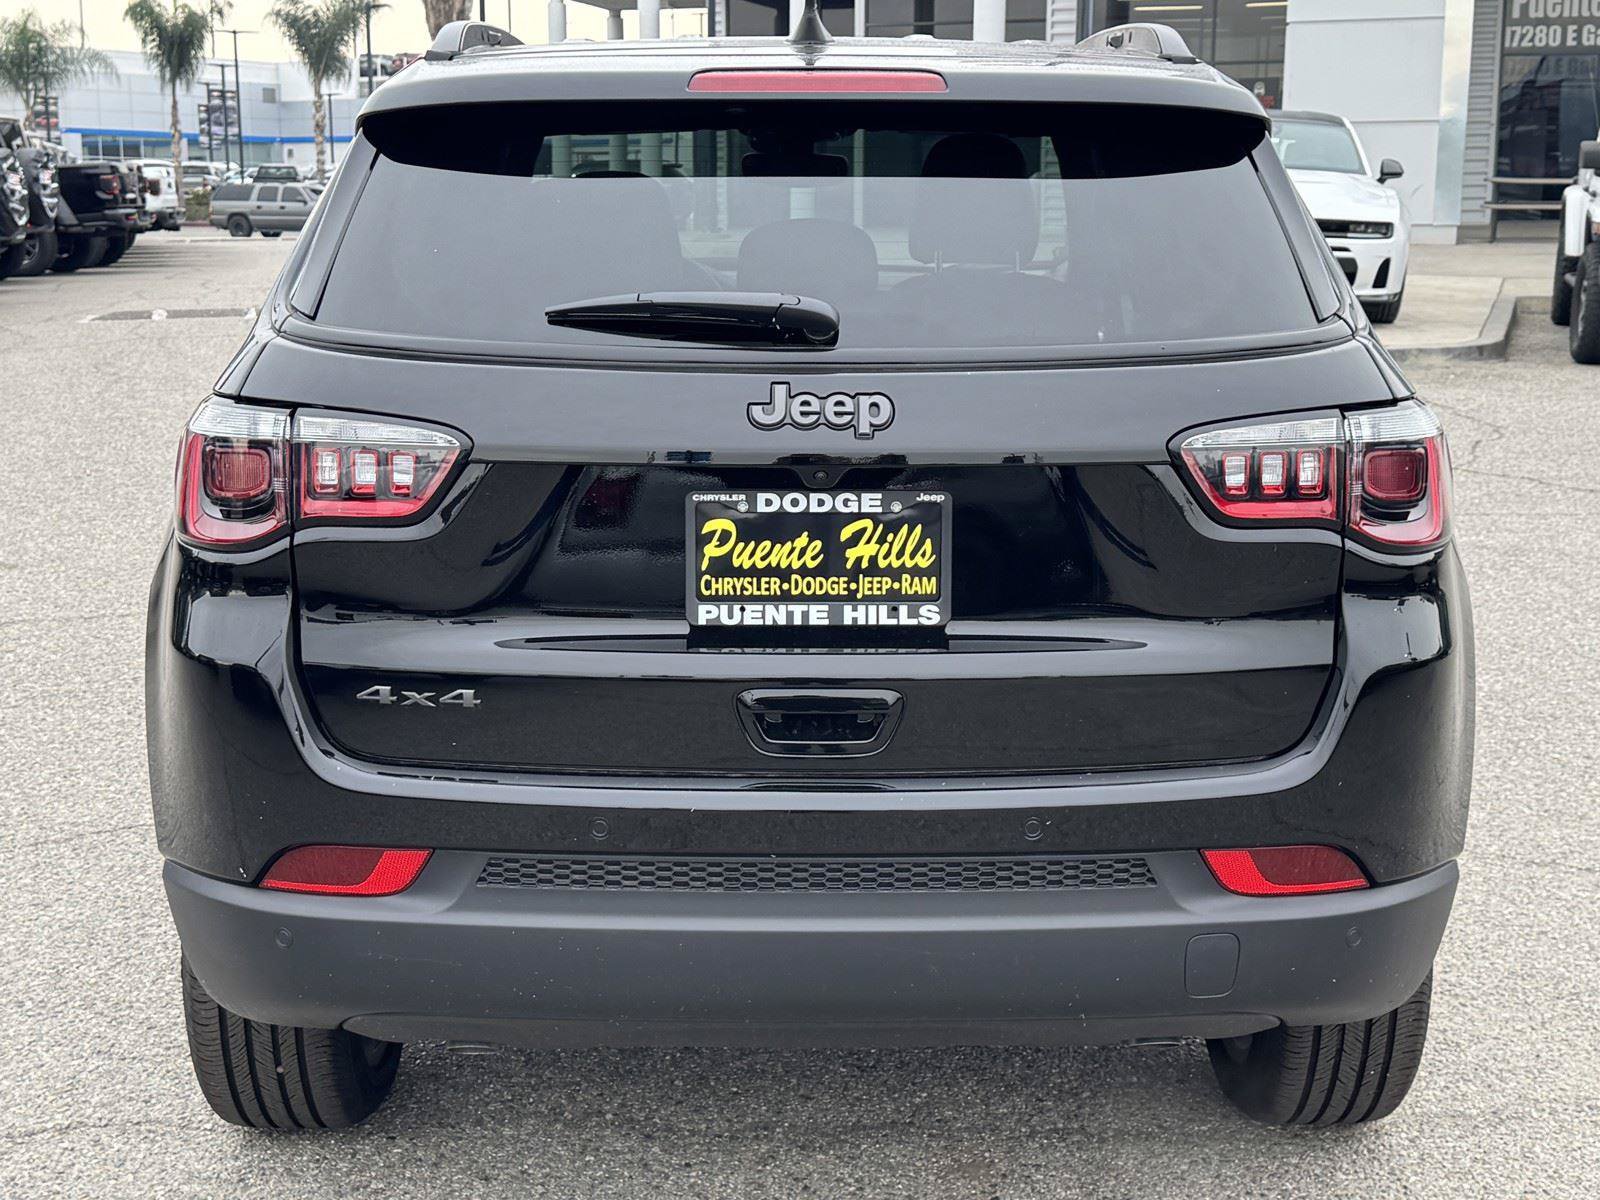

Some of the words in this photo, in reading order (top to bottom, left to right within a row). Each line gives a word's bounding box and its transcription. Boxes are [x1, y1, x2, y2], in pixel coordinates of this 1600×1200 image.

[1504, 24, 1562, 48] 17280
[1565, 24, 1578, 47] E
[747, 381, 895, 440] Jeep
[756, 492, 883, 513] DODGE
[916, 493, 945, 502] Jeep
[701, 518, 824, 571] Puente
[839, 518, 936, 570] Hills
[698, 604, 830, 625] PUENTE
[843, 604, 941, 625] HILLS
[356, 685, 482, 708] 4x4
